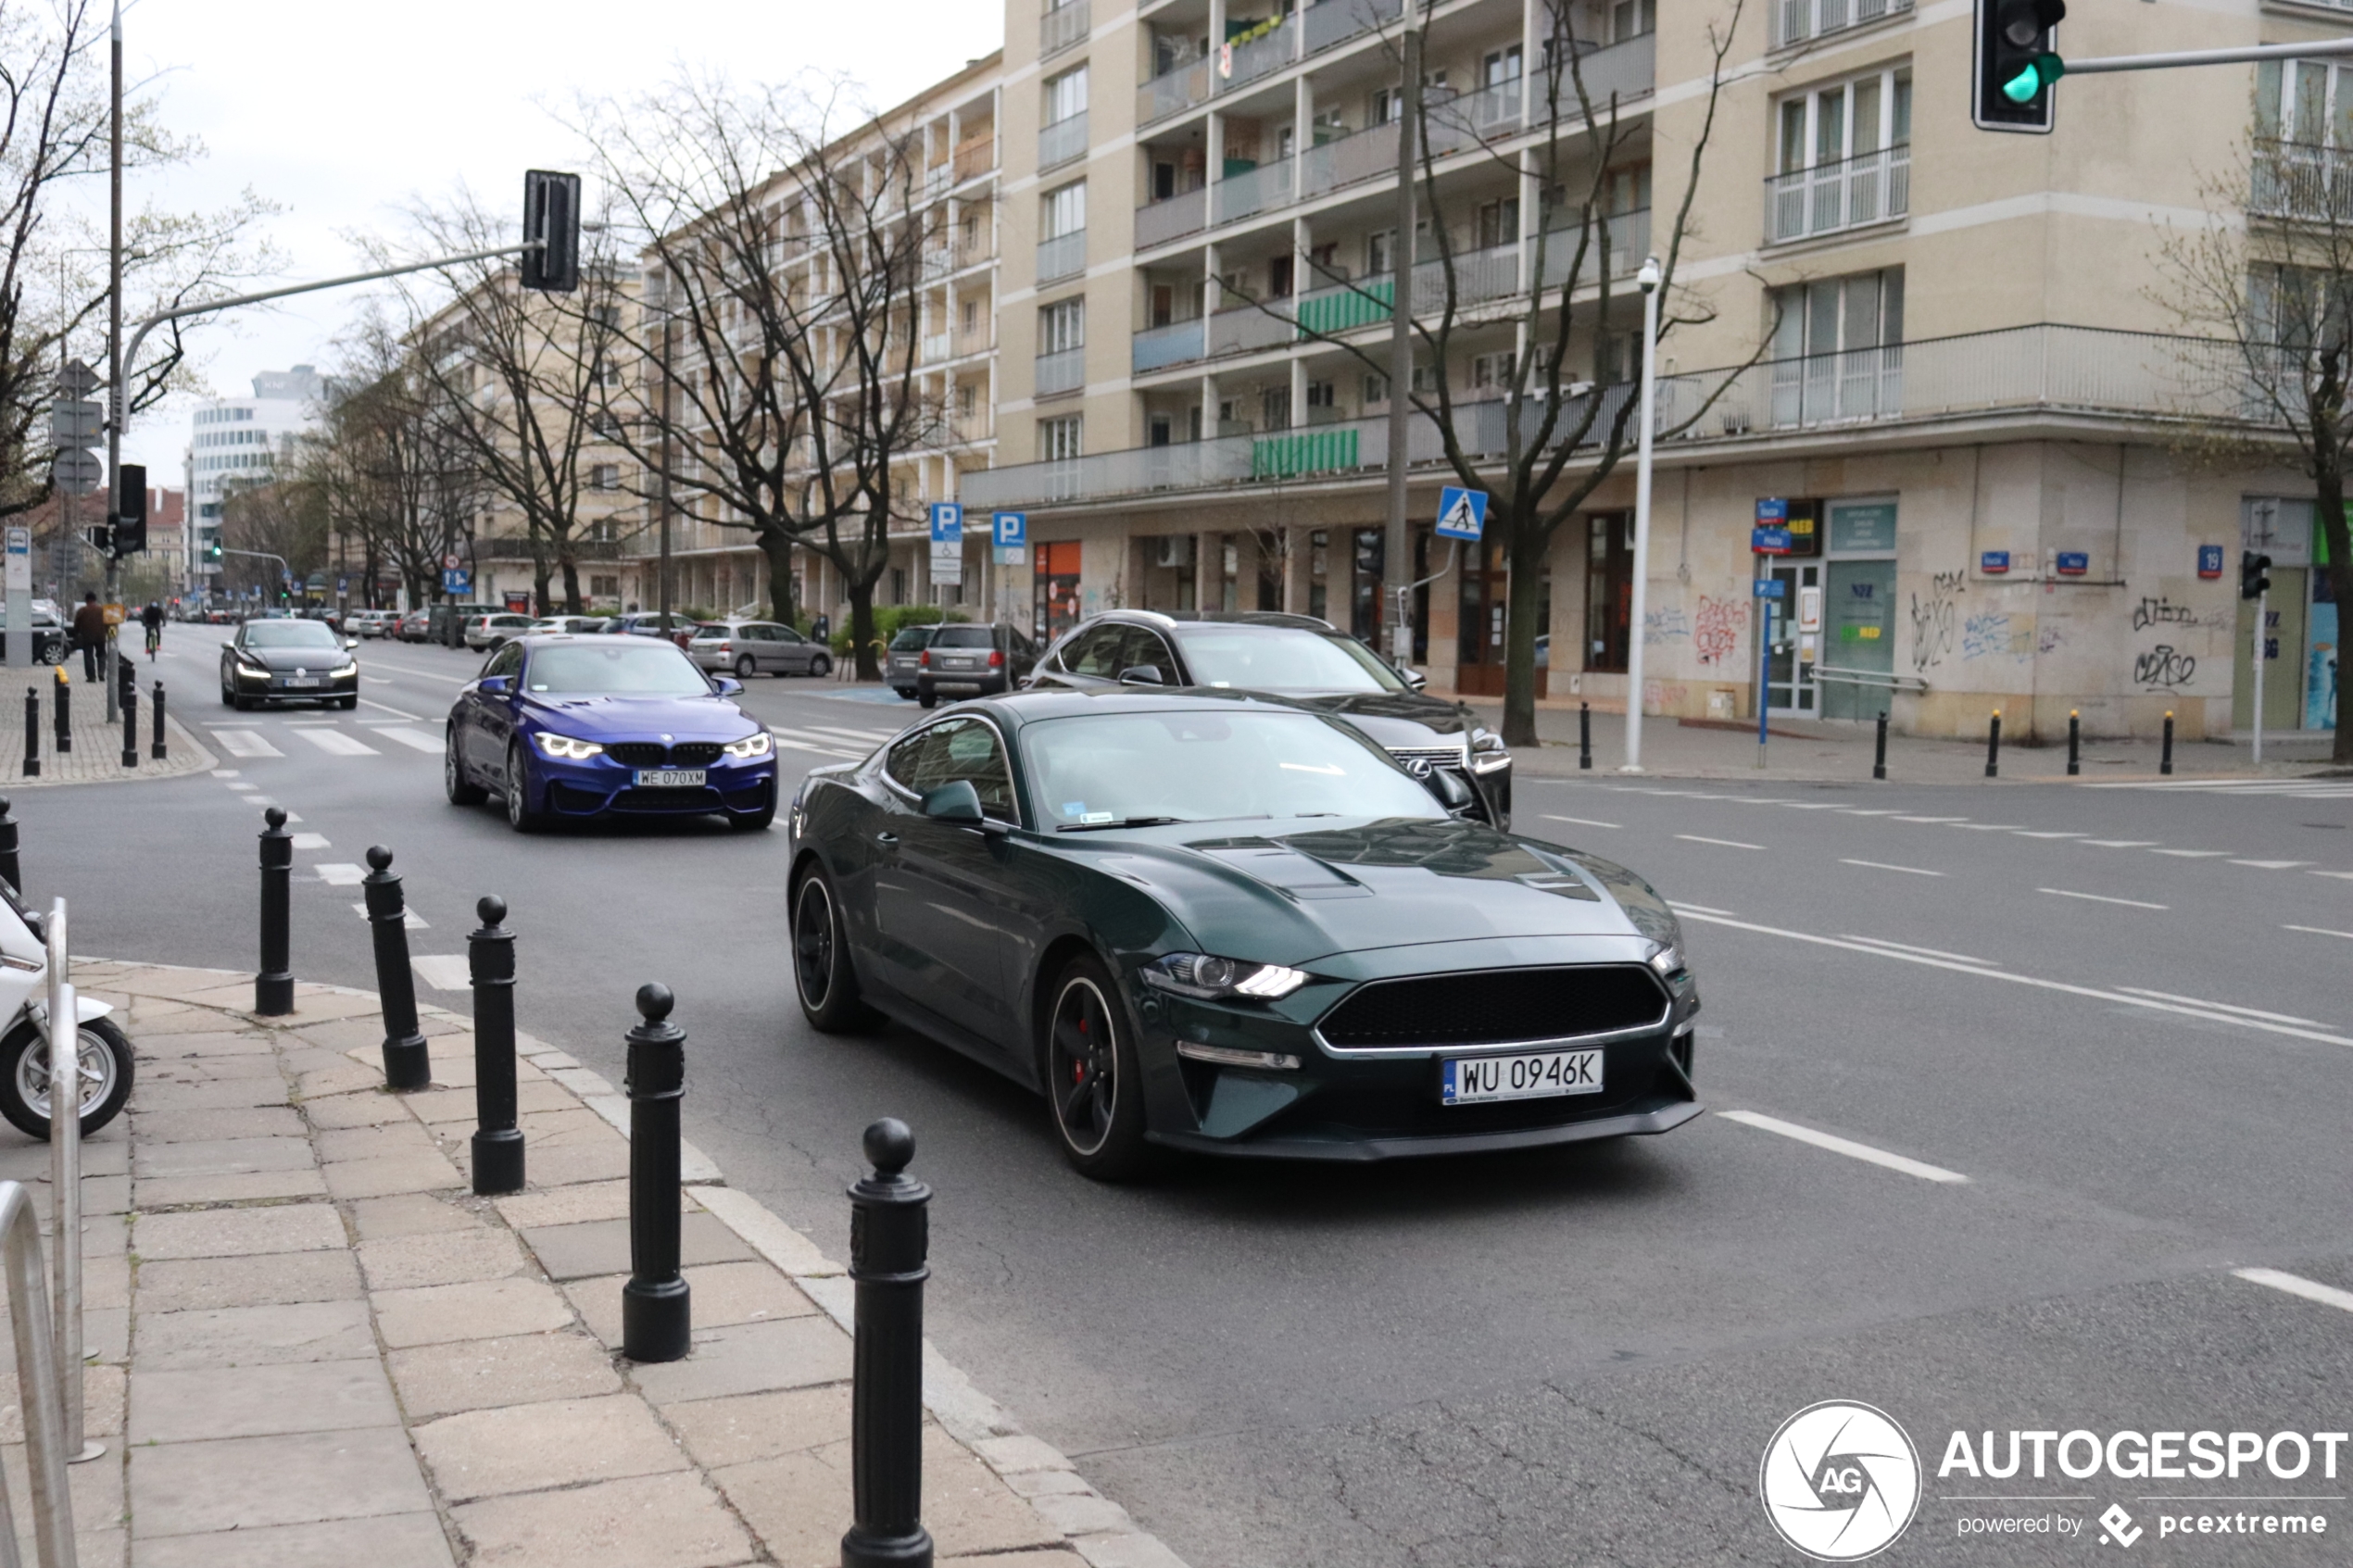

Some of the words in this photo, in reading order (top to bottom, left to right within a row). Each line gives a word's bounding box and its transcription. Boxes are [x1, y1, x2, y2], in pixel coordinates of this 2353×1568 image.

[938, 507, 957, 531] P
[1000, 516, 1019, 543] P
[2206, 553, 2219, 570] 19
[642, 771, 659, 784] WE
[663, 771, 702, 784] 070XM
[1464, 1061, 1499, 1093] WU
[1511, 1054, 1594, 1089] 0946K
[1443, 1084, 1455, 1093] PL
